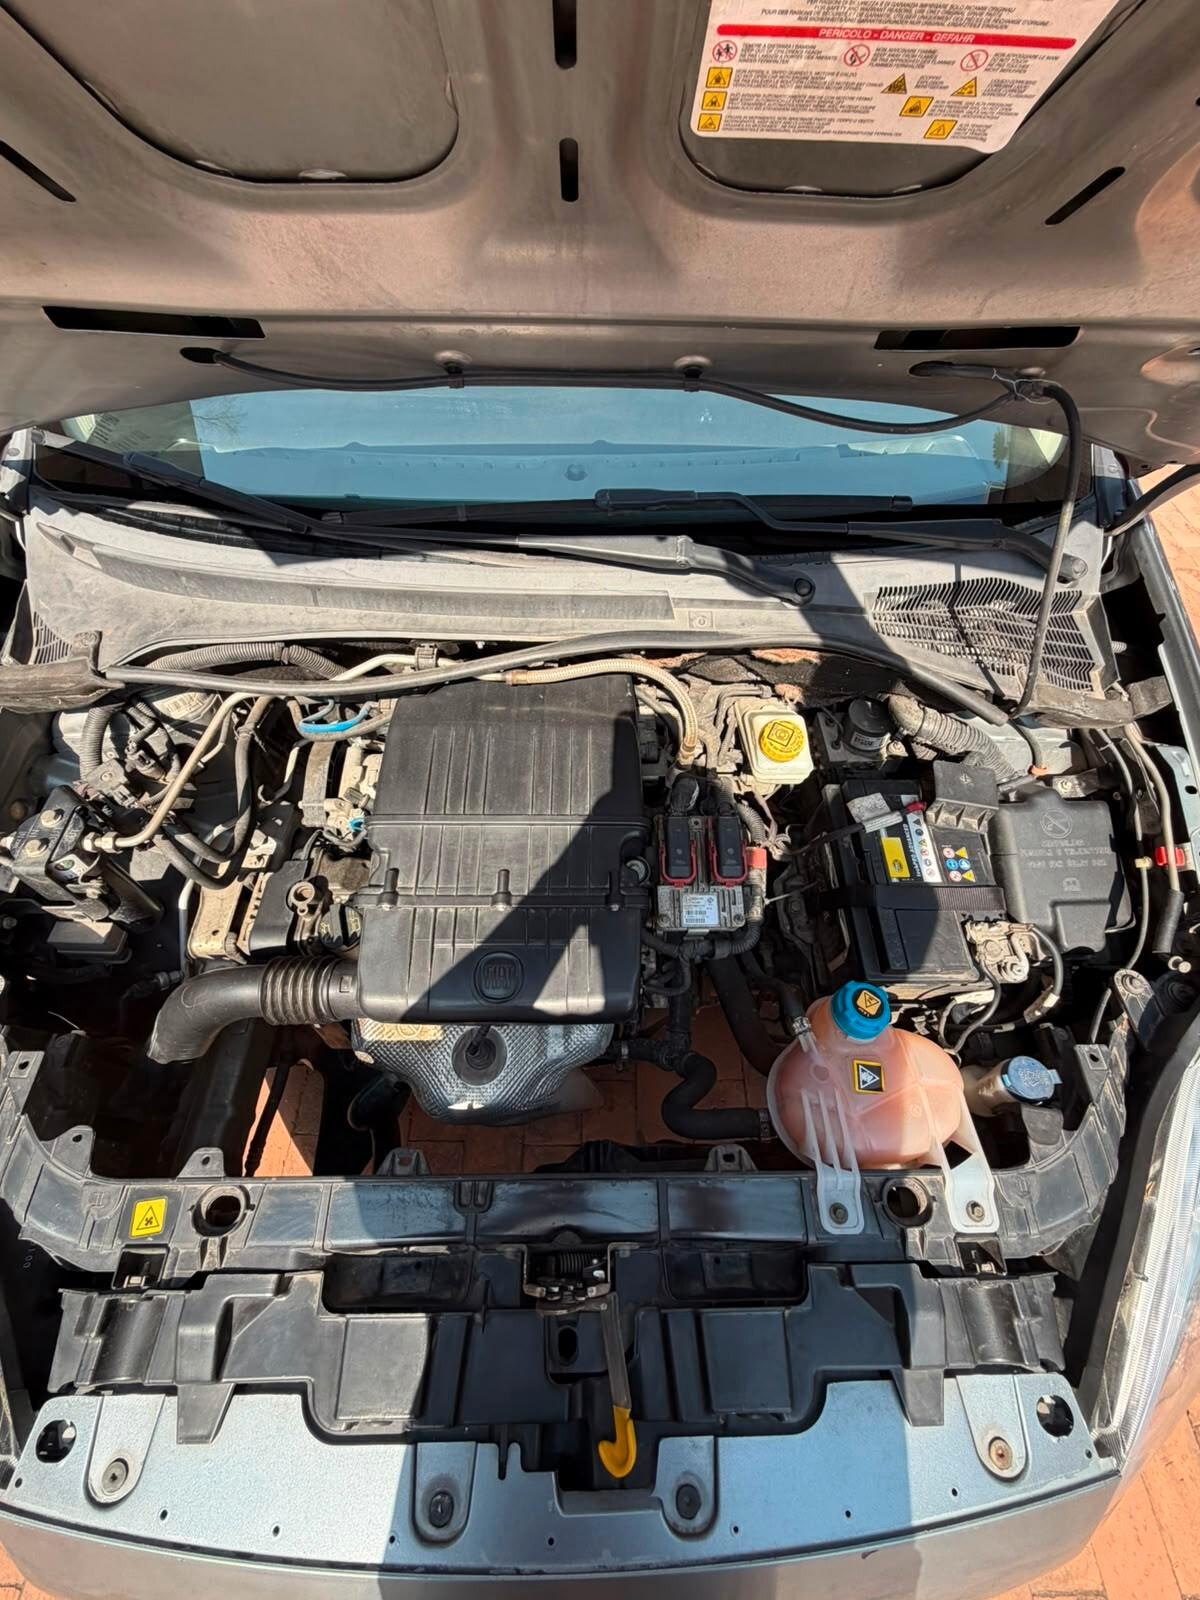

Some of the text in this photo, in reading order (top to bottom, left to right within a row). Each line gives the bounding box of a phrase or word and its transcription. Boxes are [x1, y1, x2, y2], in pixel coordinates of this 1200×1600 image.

[818, 29, 872, 38] PERICOLO
[880, 31, 924, 41] DANGER
[932, 33, 976, 43] GEFAHR
